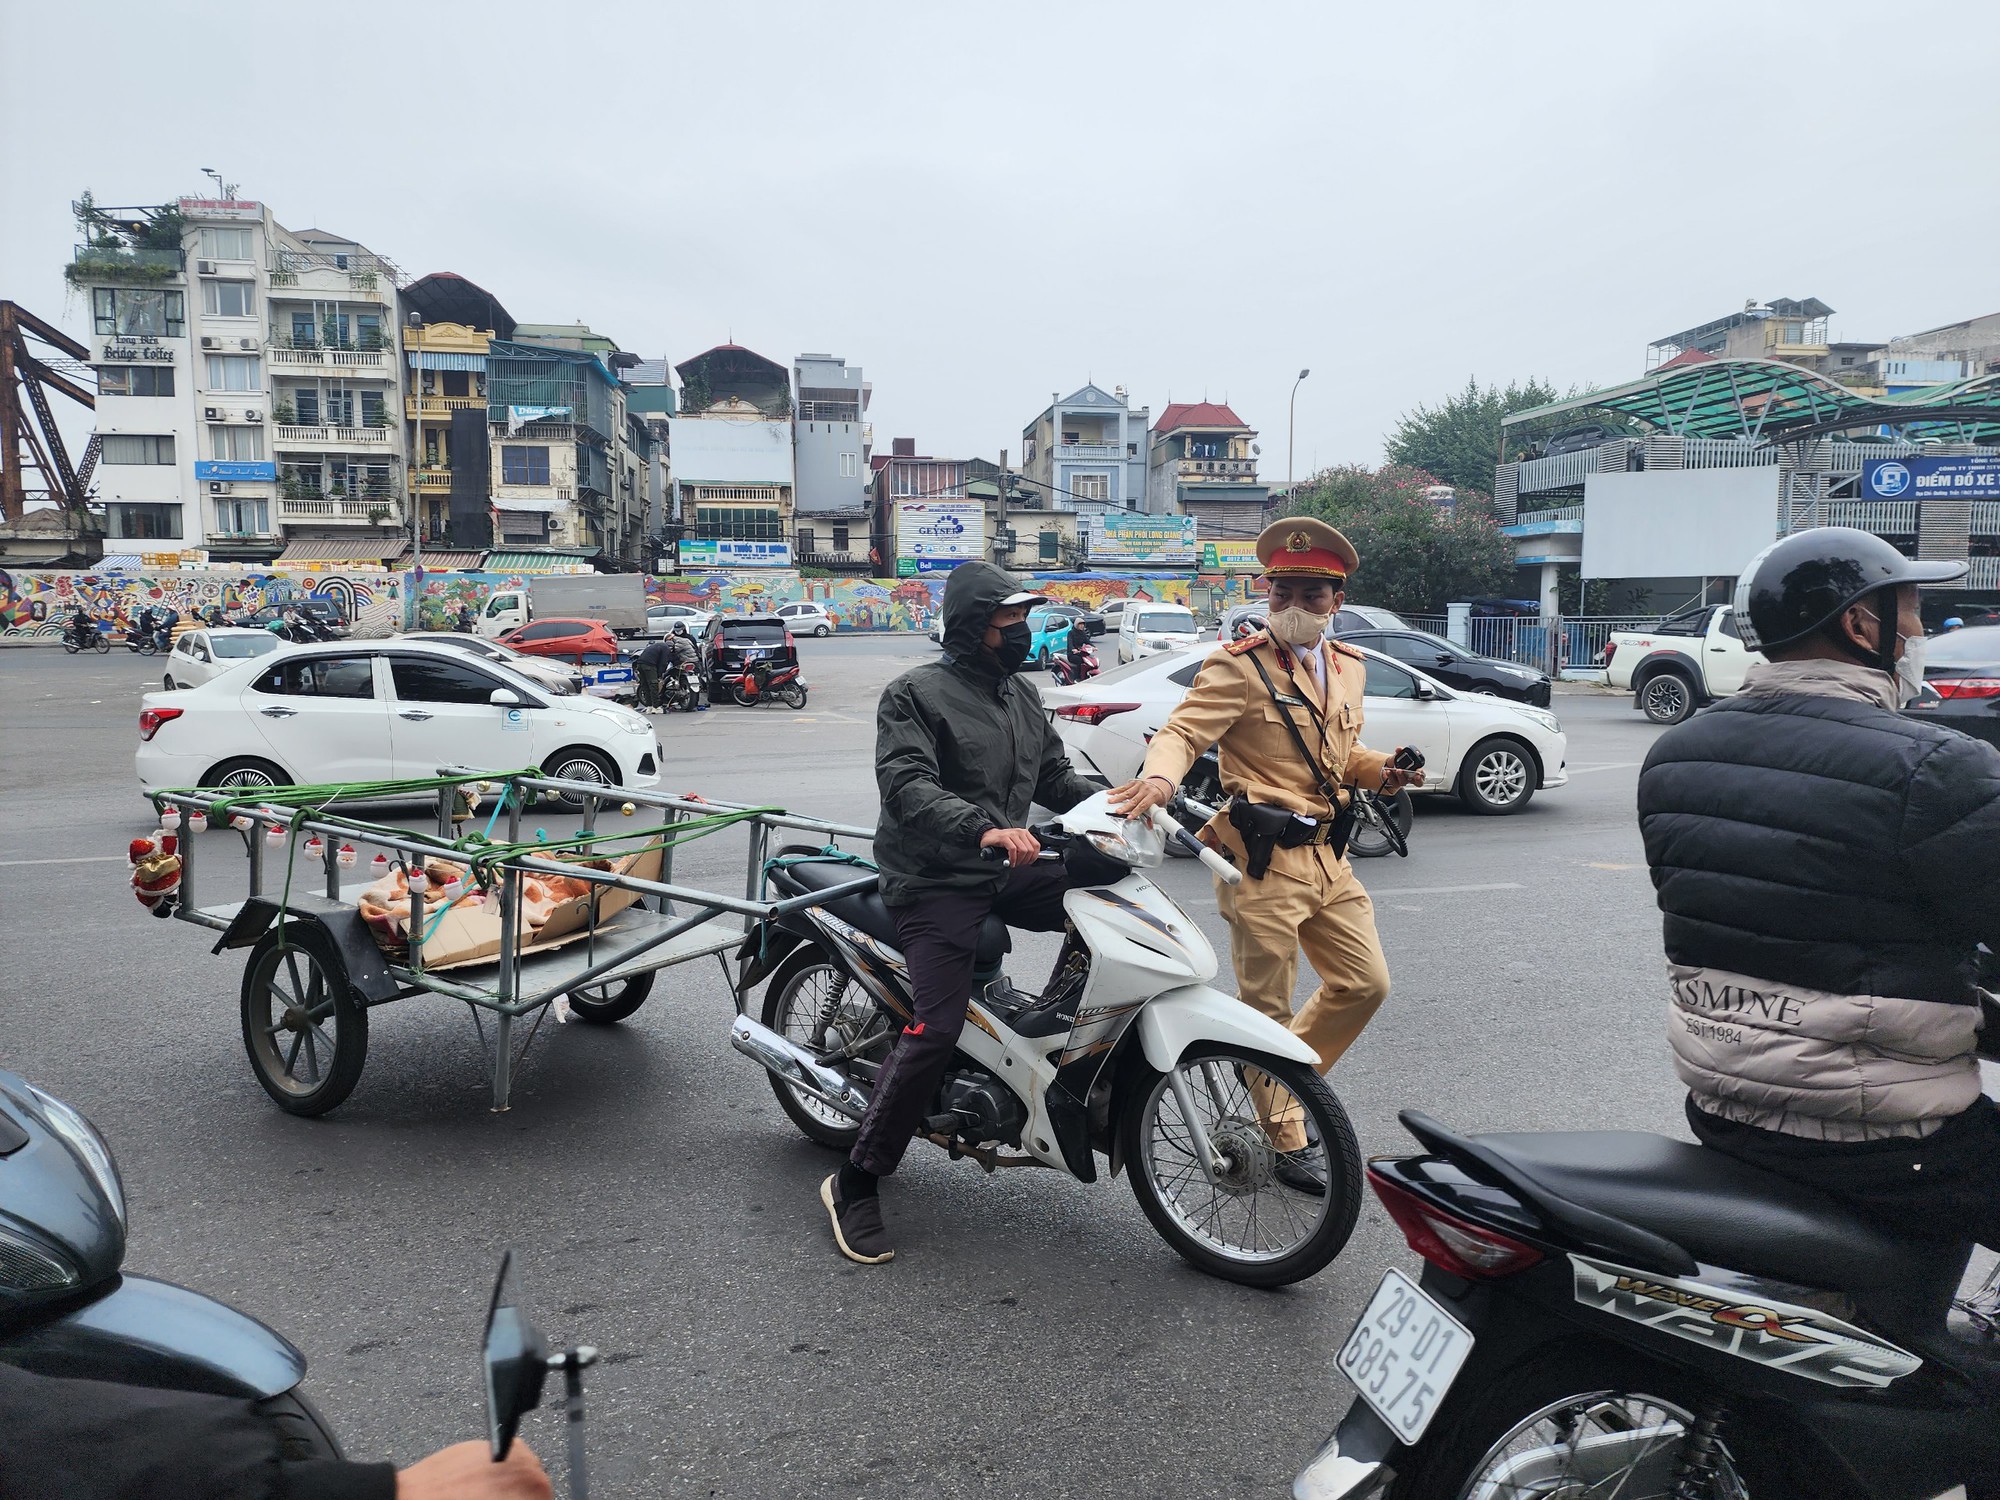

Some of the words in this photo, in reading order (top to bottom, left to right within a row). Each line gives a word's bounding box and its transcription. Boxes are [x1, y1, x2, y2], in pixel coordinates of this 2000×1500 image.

[115, 335, 136, 345] Long
[103, 345, 137, 362] Bridge
[143, 347, 175, 362] Coffee
[1916, 470, 1951, 487] ĐIỂM
[1954, 470, 1974, 487] ĐỖ
[1976, 473, 1994, 486] XE
[919, 527, 960, 536] GEYSER
[1105, 529, 1117, 539] NHÀ
[1118, 530, 1133, 539] PHÂN
[1134, 530, 1148, 539] PHỐI
[1149, 531, 1163, 539] LONG
[1163, 531, 1181, 539] GIANG
[1685, 1017, 1742, 1046] EST.1984
[1376, 1286, 1455, 1374] 29-D1
[1345, 1326, 1435, 1430] 685.75
